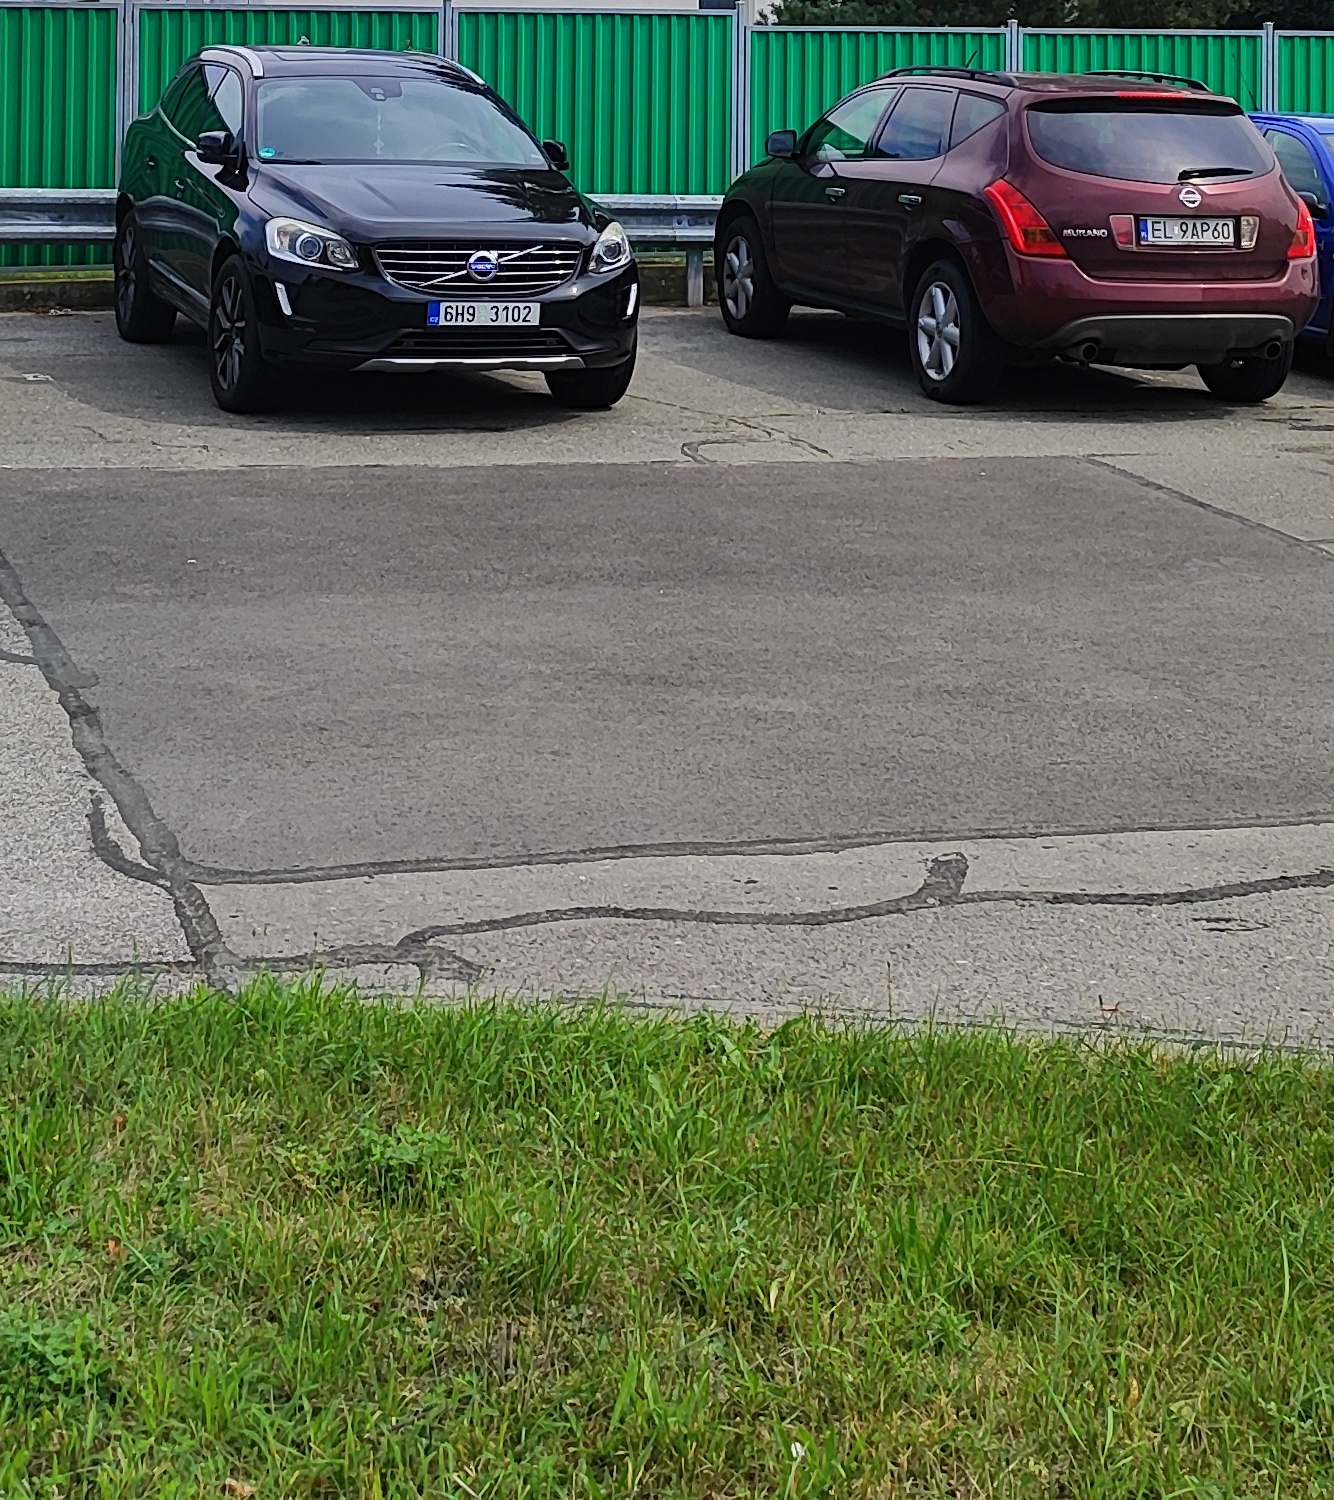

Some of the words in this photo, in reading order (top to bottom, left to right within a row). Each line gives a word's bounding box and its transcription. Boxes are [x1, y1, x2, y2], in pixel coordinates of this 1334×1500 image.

[1151, 220, 1174, 239] EL
[1179, 221, 1231, 241] 9AP60
[444, 304, 476, 323] 6H9
[489, 304, 532, 323] 3102
